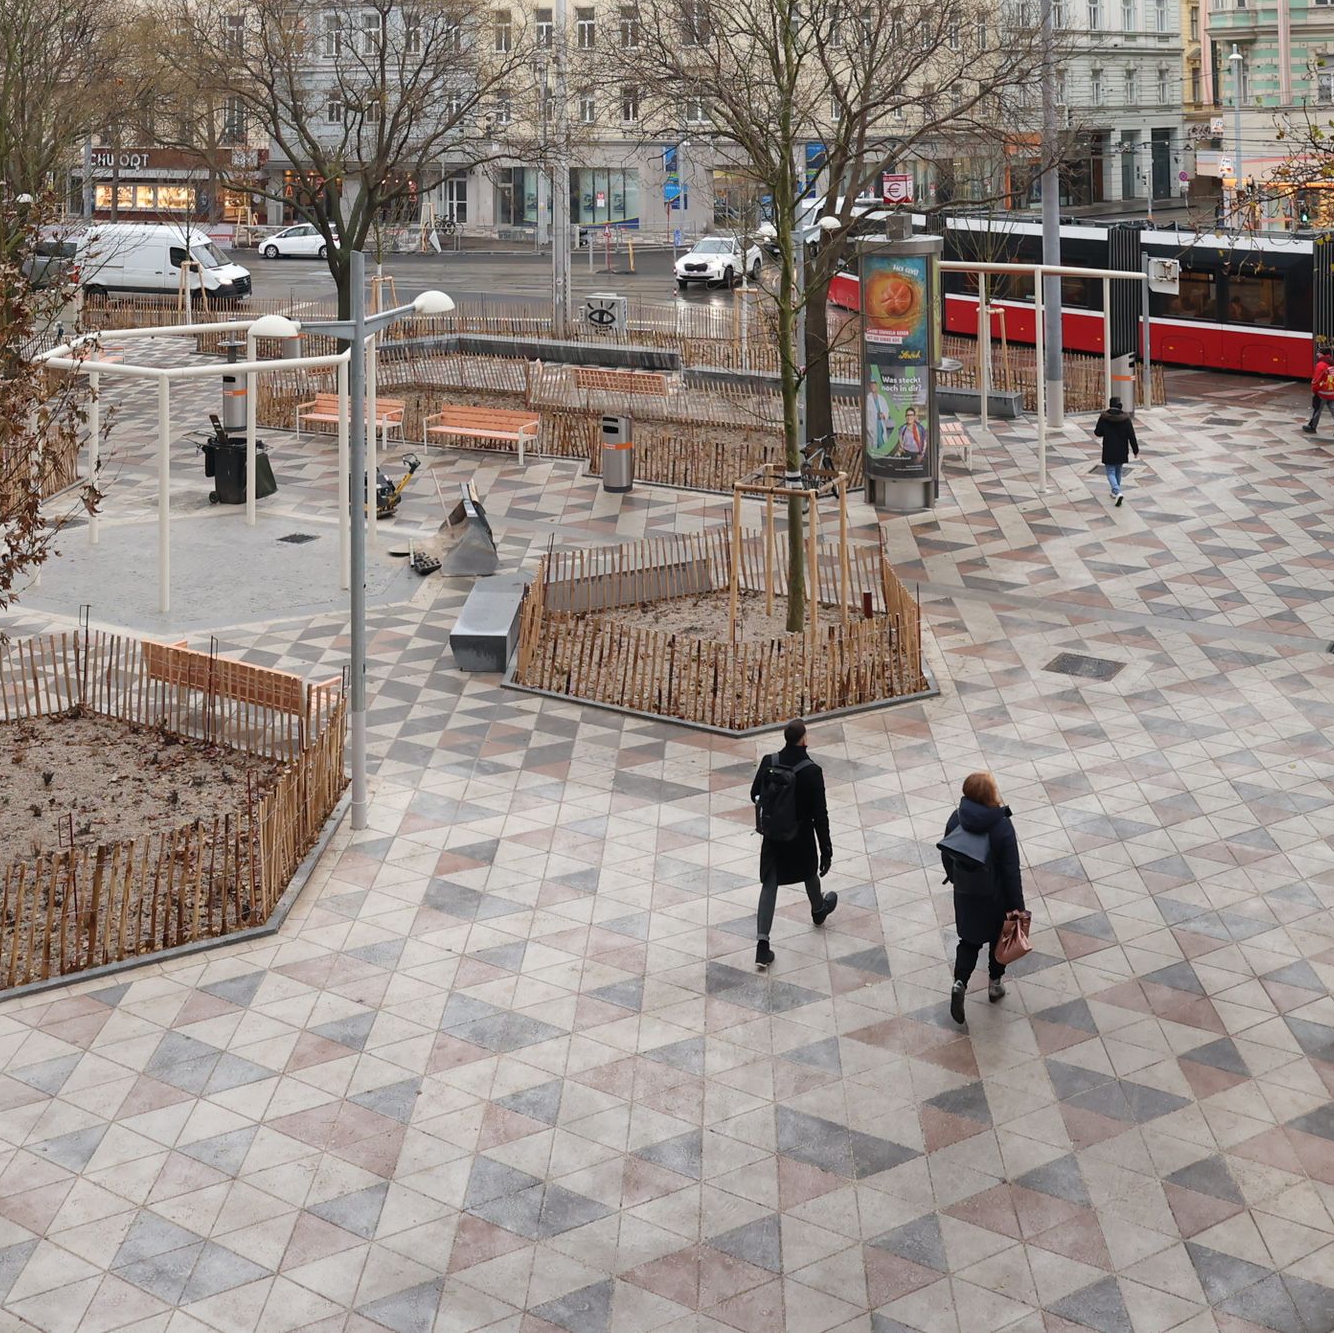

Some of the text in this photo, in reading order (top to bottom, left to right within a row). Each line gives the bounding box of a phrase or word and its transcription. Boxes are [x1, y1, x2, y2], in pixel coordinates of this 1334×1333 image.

[881, 375, 921, 384] Was steckt
[881, 384, 898, 392] noch
[899, 384, 907, 392] in
